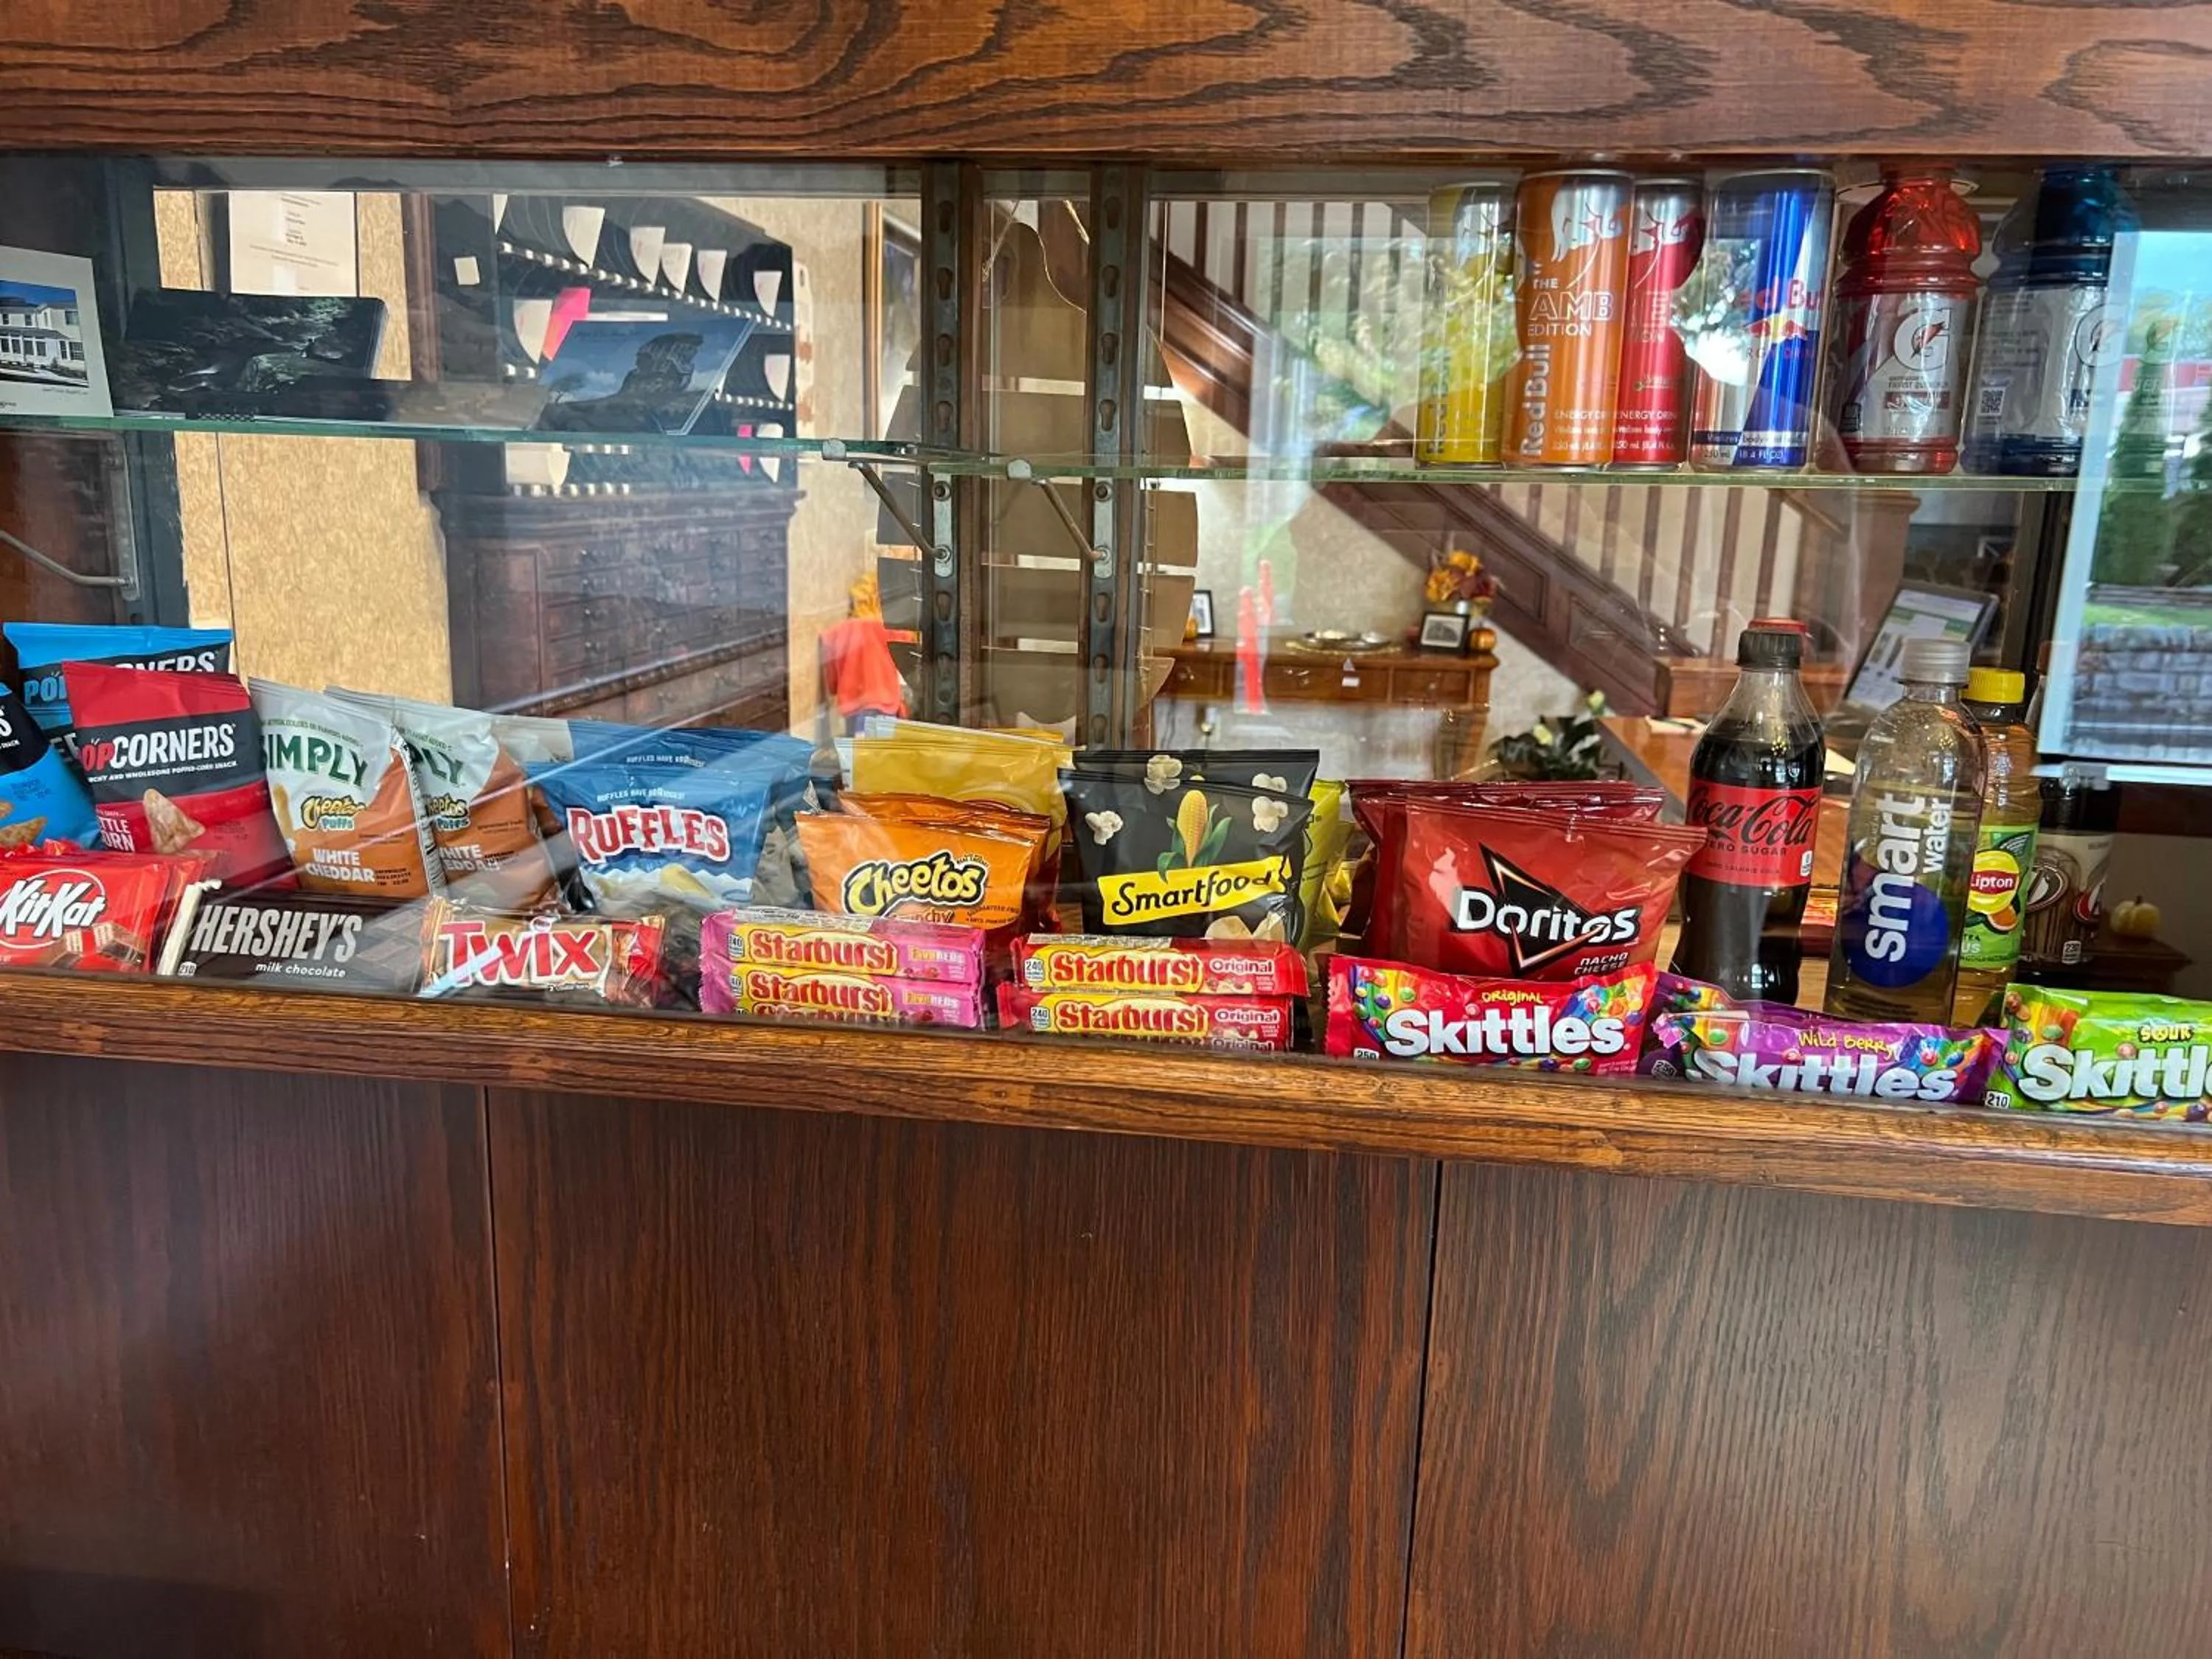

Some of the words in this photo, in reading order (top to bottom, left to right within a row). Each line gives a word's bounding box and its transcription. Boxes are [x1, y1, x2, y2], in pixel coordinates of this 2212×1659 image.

[1534, 278, 1559, 288] THE
[1528, 323, 1591, 336] EDITION
[1525, 344, 1551, 397] Bull
[1520, 401, 1545, 456] Red
[126, 768, 170, 779] WHOLESOME
[260, 734, 369, 787] IMPLY
[567, 806, 729, 863] RUFFLES
[1705, 839, 1735, 852] ERO
[1741, 846, 1787, 856] SUGAR
[305, 863, 375, 883] CHEDDAR
[313, 849, 360, 865] WHITE
[846, 852, 984, 916] Cheetos
[1111, 870, 1271, 916] Smartfood
[1865, 793, 1925, 962] smart
[1923, 797, 1951, 873] water
[1971, 874, 2014, 890] Lipton
[1457, 891, 1638, 942] Doritos
[190, 905, 363, 963] HERSHEY'S
[750, 931, 896, 970] Starburst
[256, 961, 282, 975] milk
[285, 964, 346, 978] chocolate
[1026, 961, 1043, 971] 240
[1051, 952, 1202, 987] Starburst
[1211, 959, 1273, 975] Original
[1574, 961, 1625, 975] CHEESE
[1580, 952, 1628, 967] NACHO
[747, 973, 892, 1012] Starburst
[1032, 1008, 1048, 1018] 240
[1057, 1001, 1207, 1033] Starburst
[1217, 1010, 1279, 1025] Original
[1384, 1006, 1625, 1057] Skittles
[2140, 1025, 2192, 1042] SOUR
[1694, 1051, 1958, 1101] Skittles
[2019, 1043, 2212, 1101] Skittl
[1986, 1093, 2008, 1107] 210
